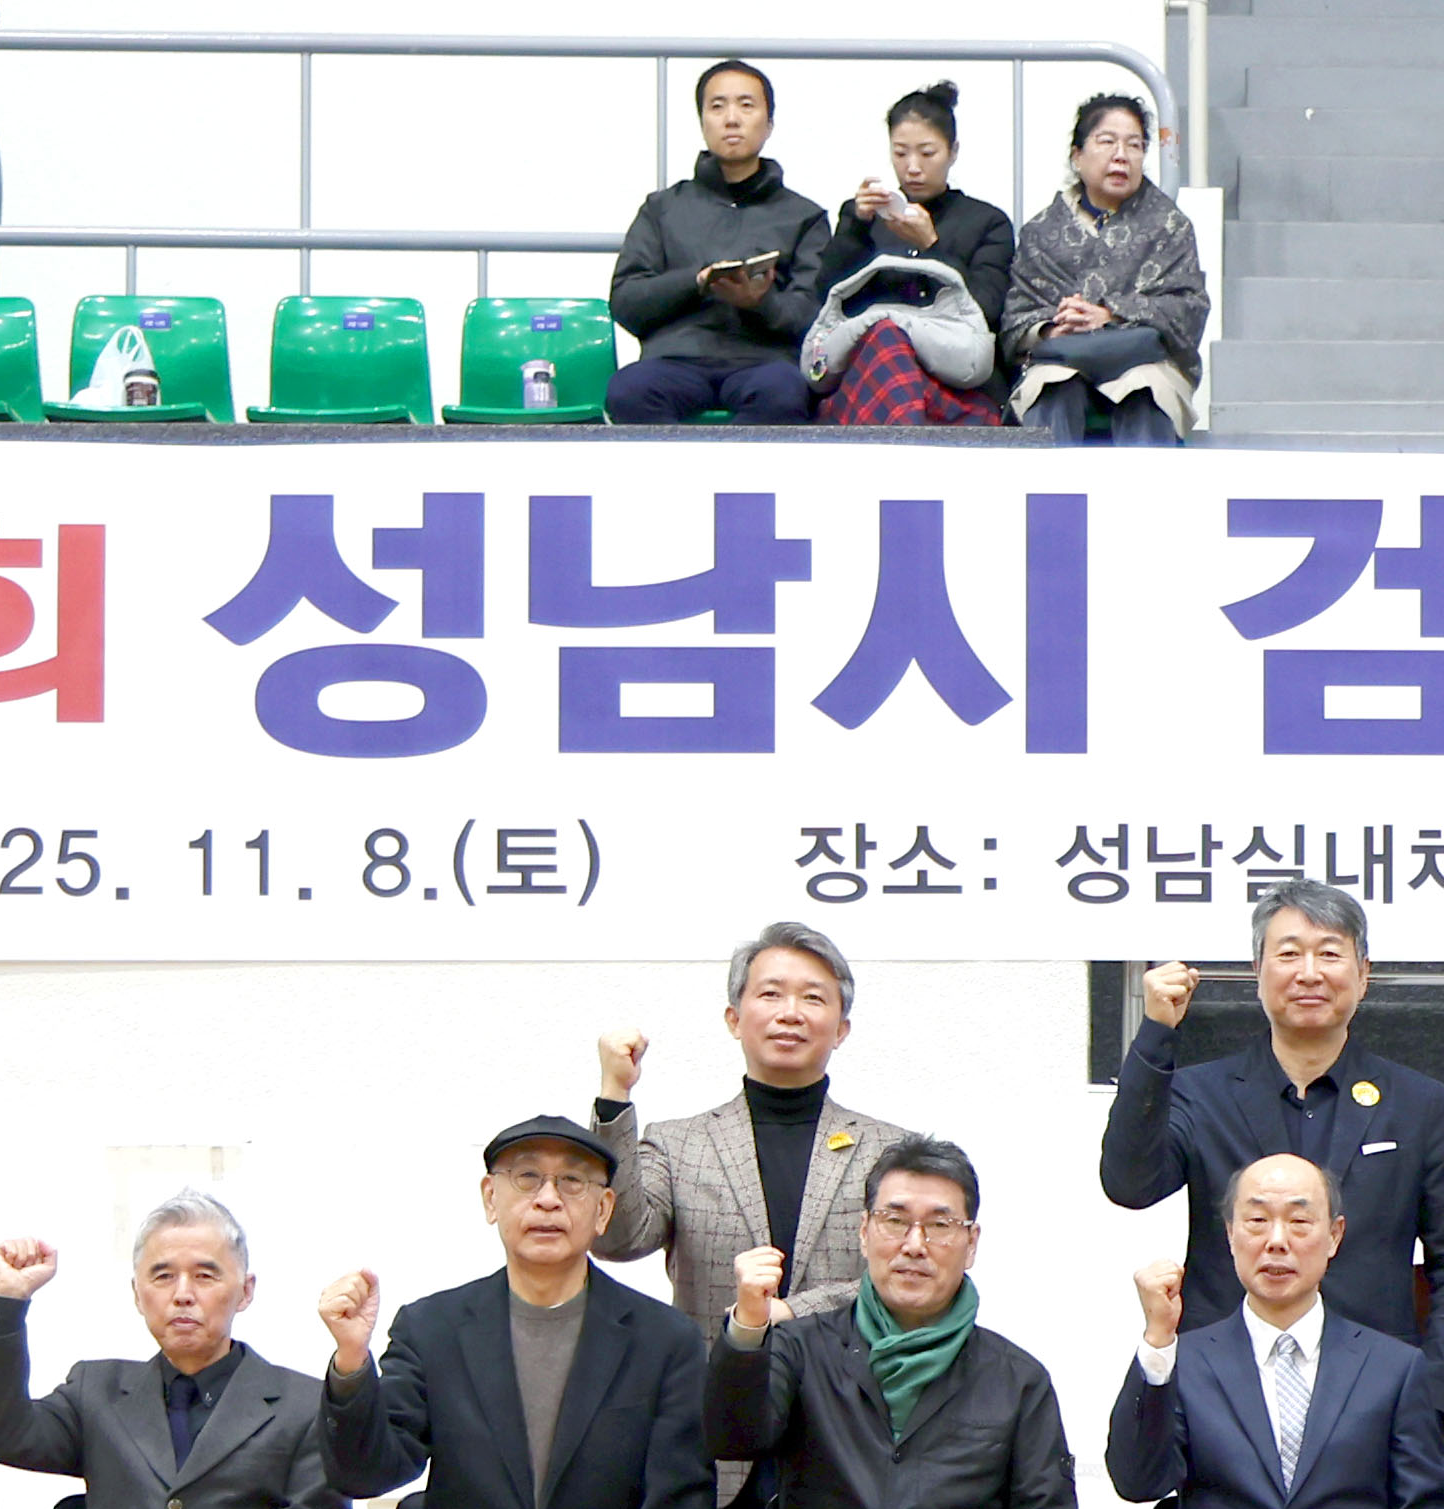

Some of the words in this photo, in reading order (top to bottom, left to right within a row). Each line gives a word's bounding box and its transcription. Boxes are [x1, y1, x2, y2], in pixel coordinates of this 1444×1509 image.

[206, 493, 1096, 757] 성남시
[189, 829, 312, 899] 11.
[363, 820, 599, 905] 8.(토)
[778, 823, 996, 901] 장소:
